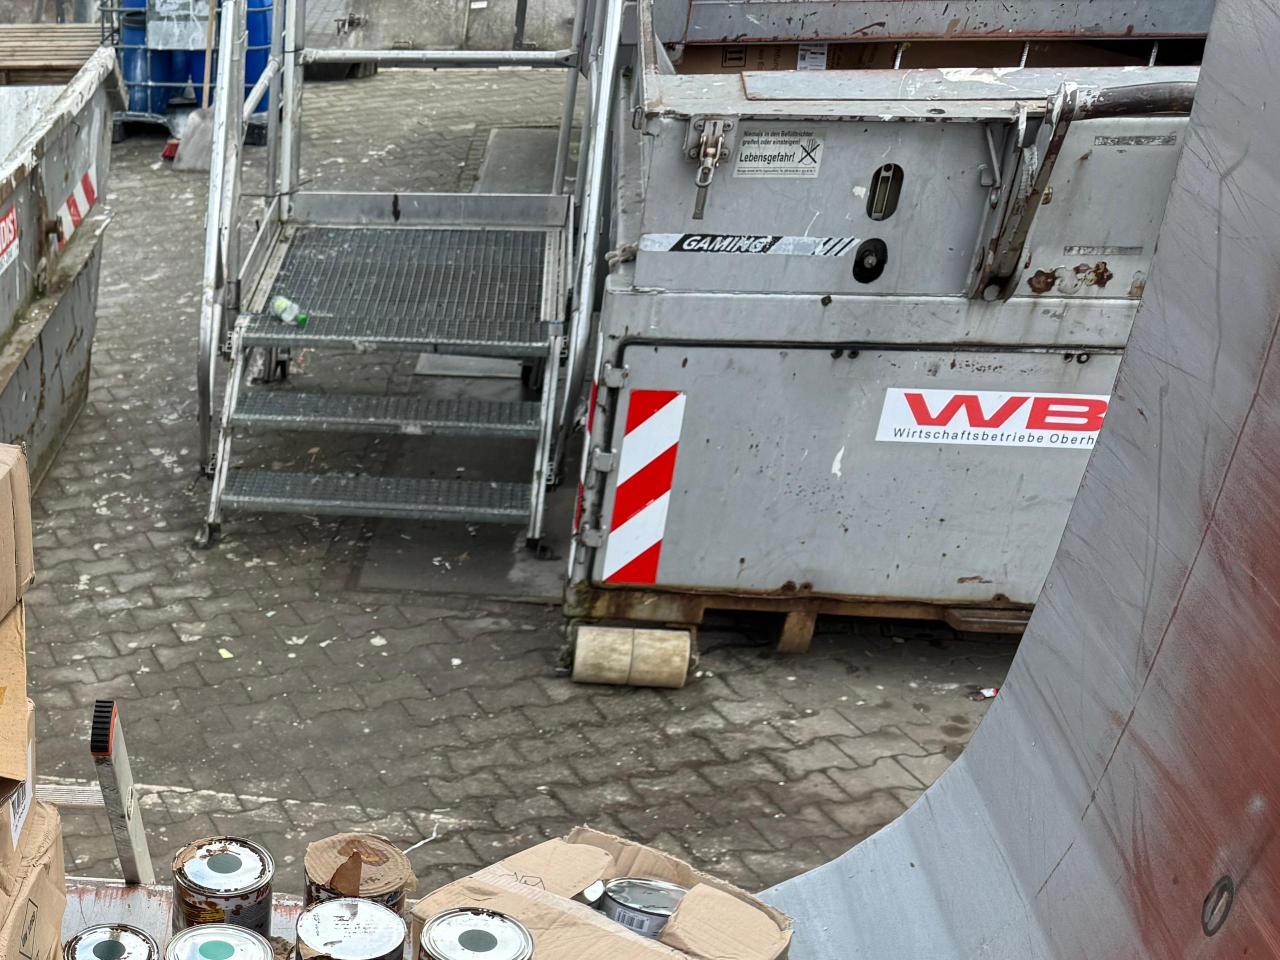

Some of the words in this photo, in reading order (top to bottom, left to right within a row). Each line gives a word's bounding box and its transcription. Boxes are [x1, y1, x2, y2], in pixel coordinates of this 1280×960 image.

[740, 152, 796, 164] Lebensgefahr!
[682, 235, 767, 252] GAMING
[893, 428, 1044, 443] Wirtschaftsbetriebe
